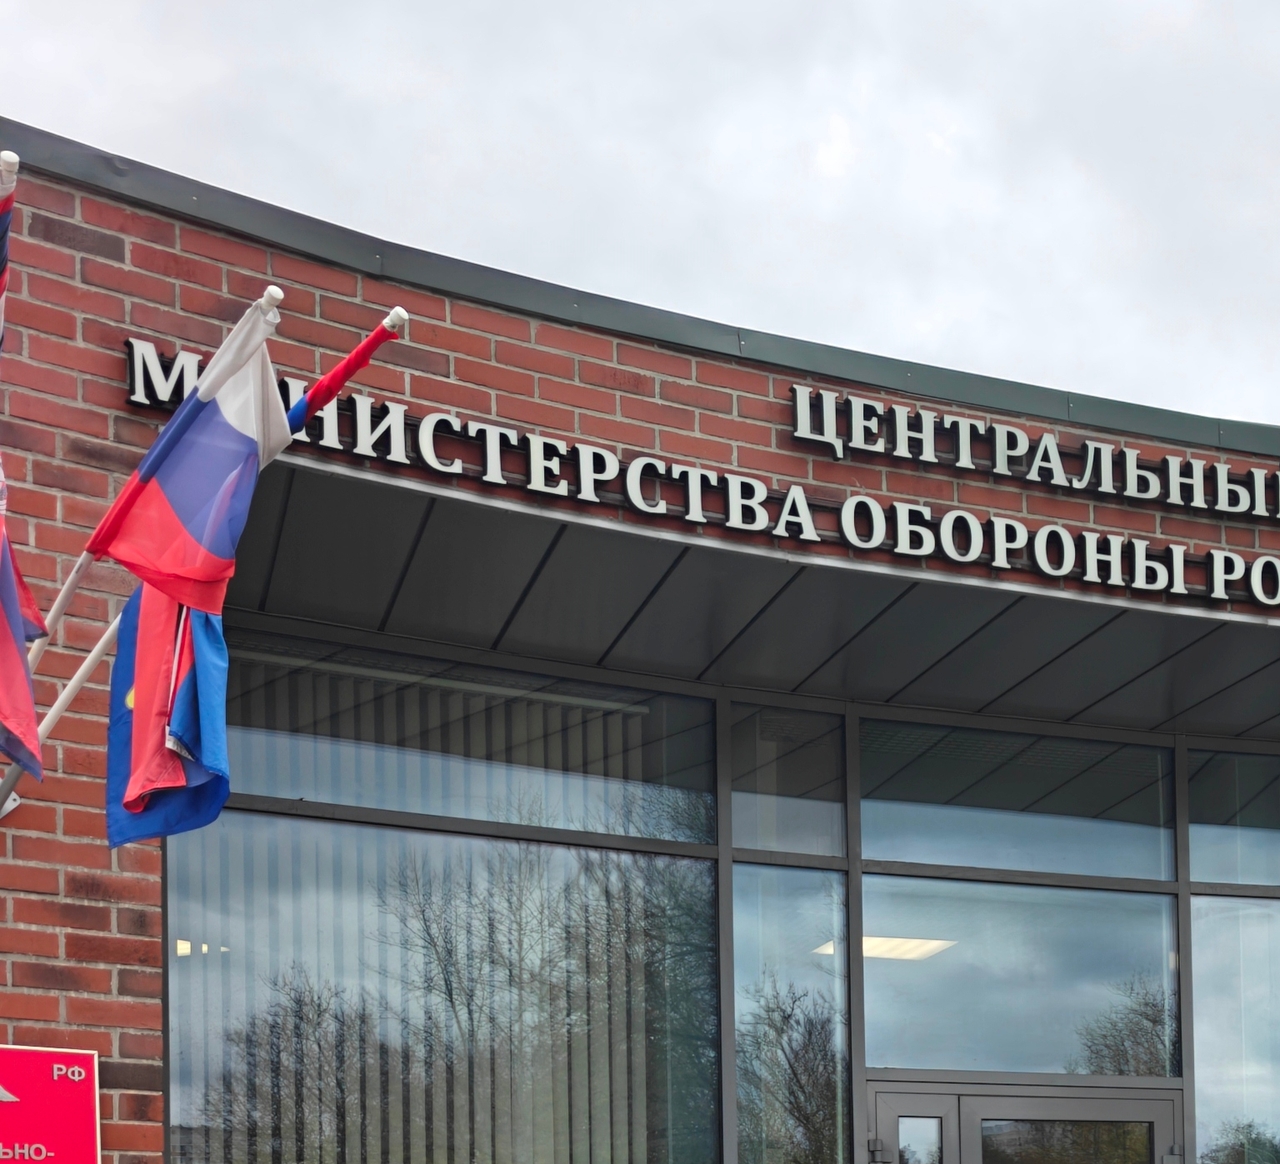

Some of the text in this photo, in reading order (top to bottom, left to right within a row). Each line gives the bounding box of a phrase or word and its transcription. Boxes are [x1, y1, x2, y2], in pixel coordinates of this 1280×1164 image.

[125, 337, 821, 541] МНИСТЕРСТВА
[840, 495, 1188, 594] ОБОРОНЫ
[53, 1064, 86, 1082] РФ
